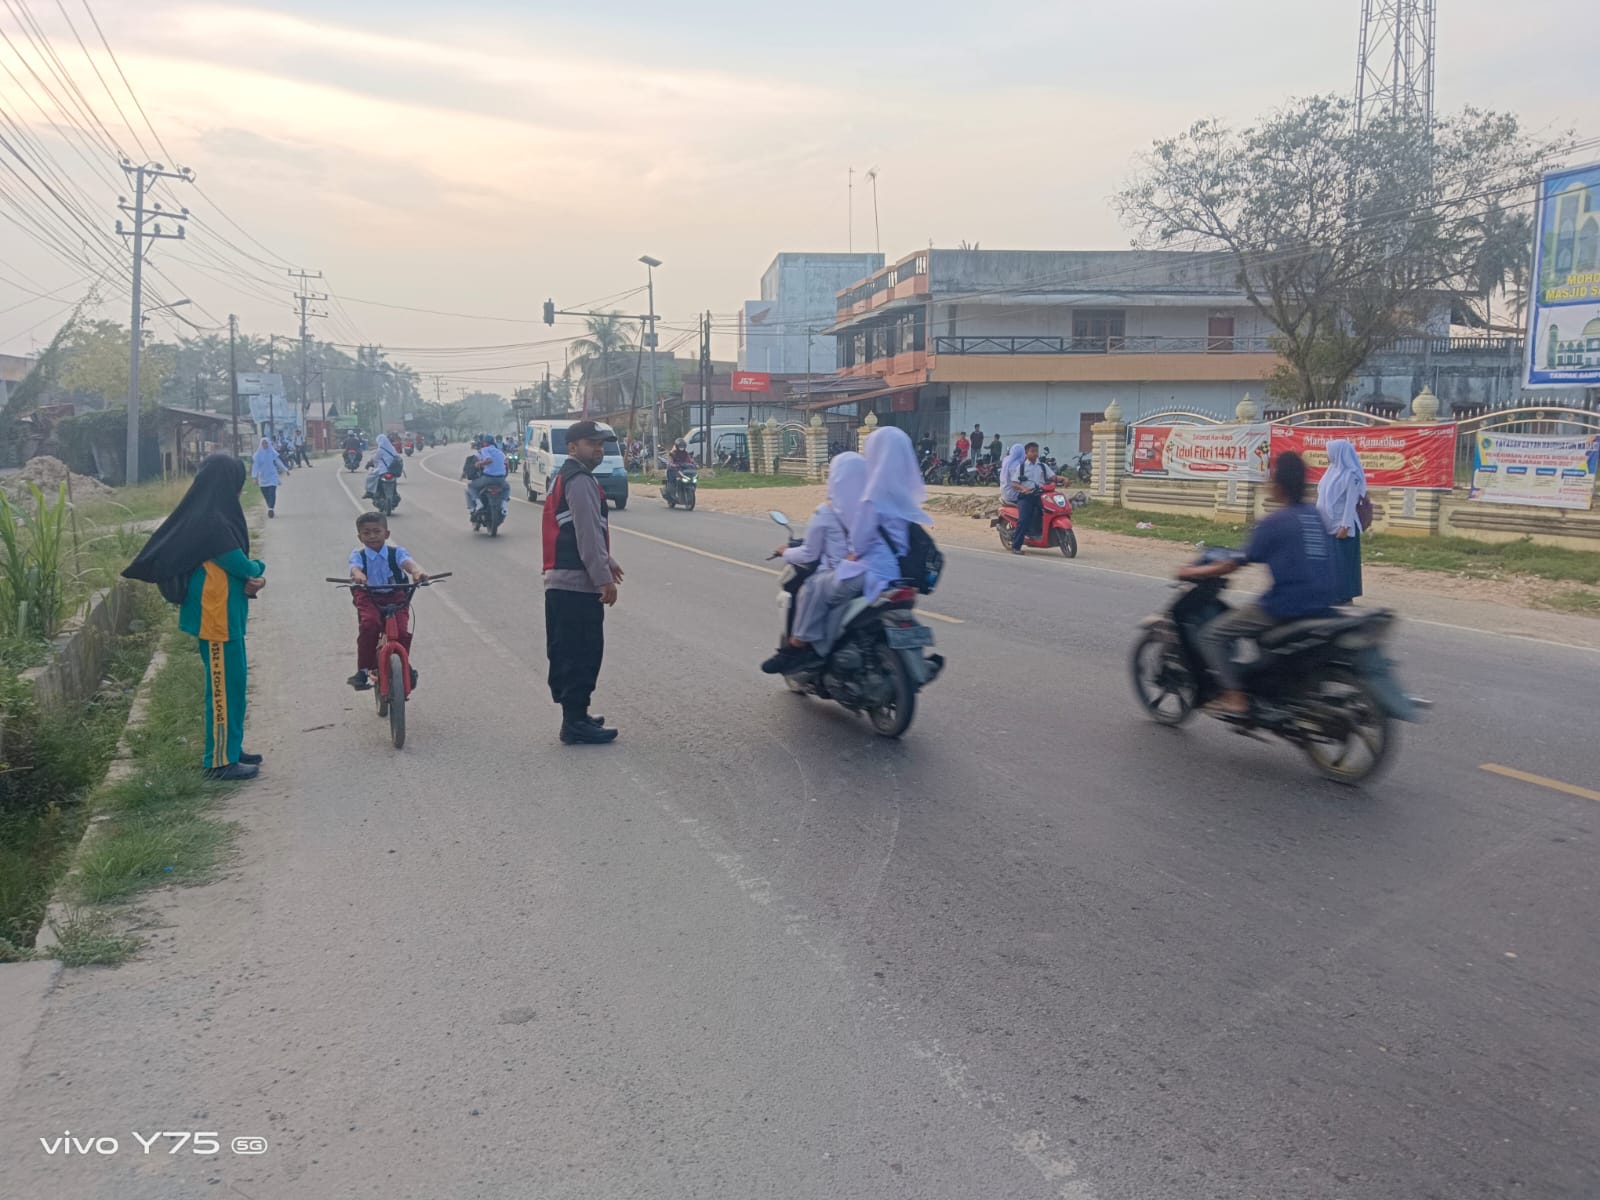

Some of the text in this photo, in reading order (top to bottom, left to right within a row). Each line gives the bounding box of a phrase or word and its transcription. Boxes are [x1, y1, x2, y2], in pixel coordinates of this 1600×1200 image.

[1545, 286, 1587, 301] MASJID
[1360, 437, 1405, 448] Ramadhan
[1175, 445, 1247, 460] Idul Fitri 1447 H
